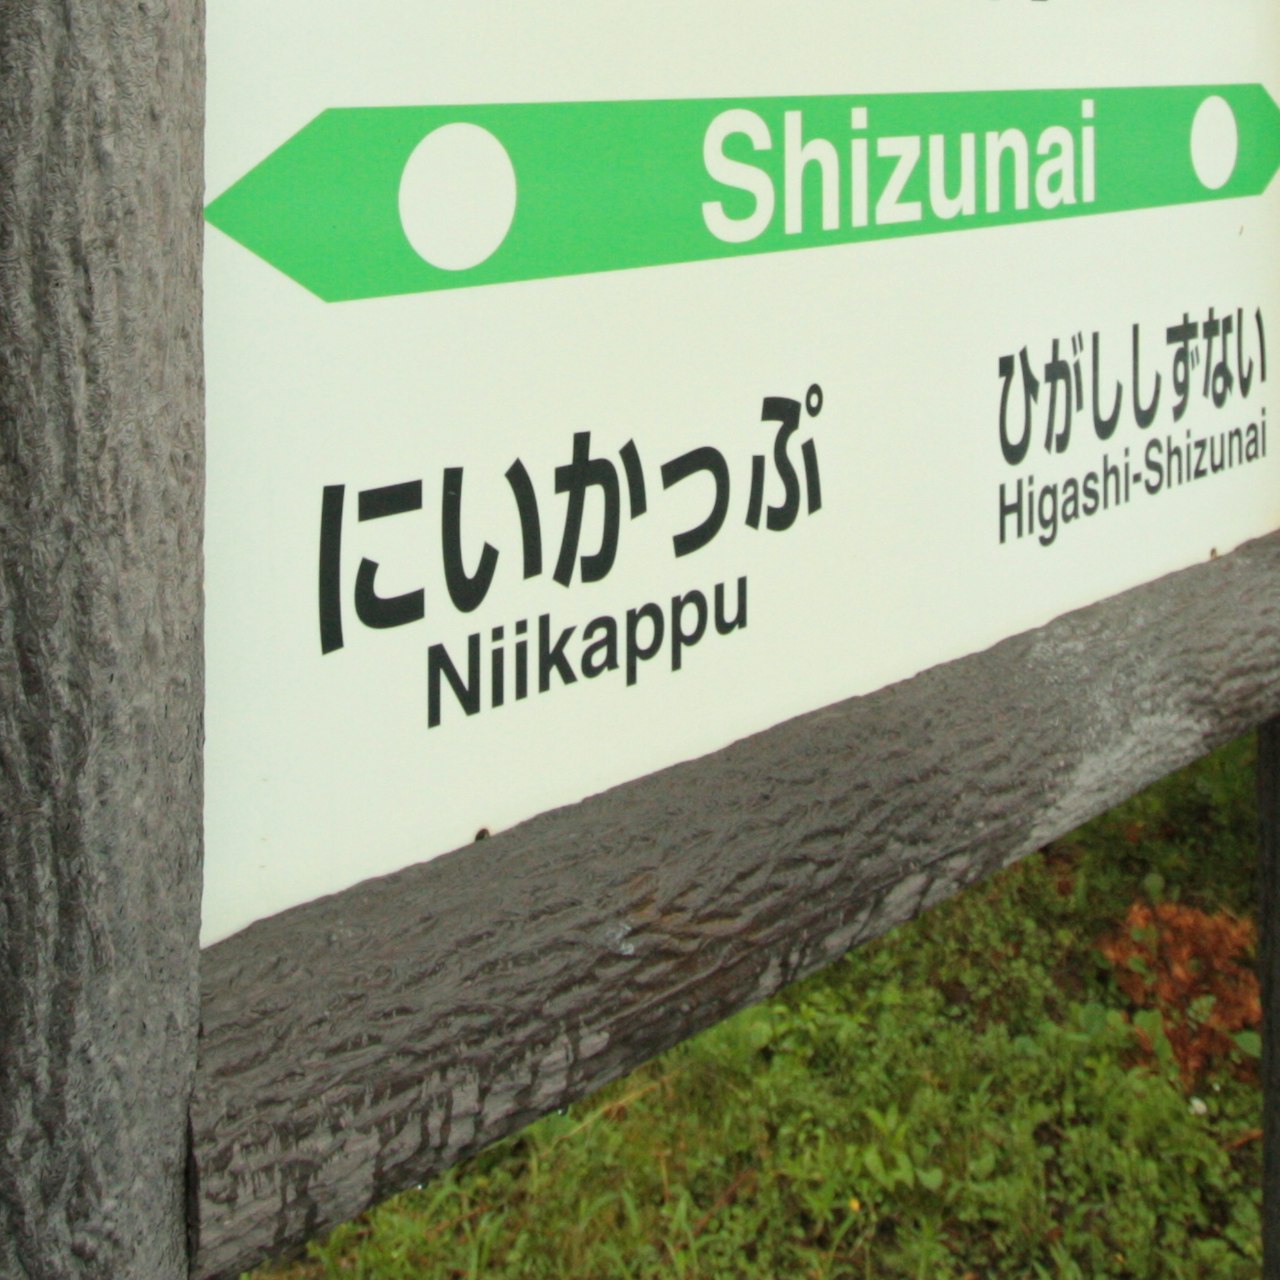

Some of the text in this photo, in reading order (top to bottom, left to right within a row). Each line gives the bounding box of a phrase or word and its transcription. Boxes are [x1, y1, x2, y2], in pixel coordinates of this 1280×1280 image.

[701, 98, 1096, 244] Shizunai
[997, 306, 1268, 466] ひがししずない
[318, 382, 825, 656] にいかっぷ
[997, 408, 1268, 548] Higashi-Shizunai
[426, 574, 749, 730] Niikappu
